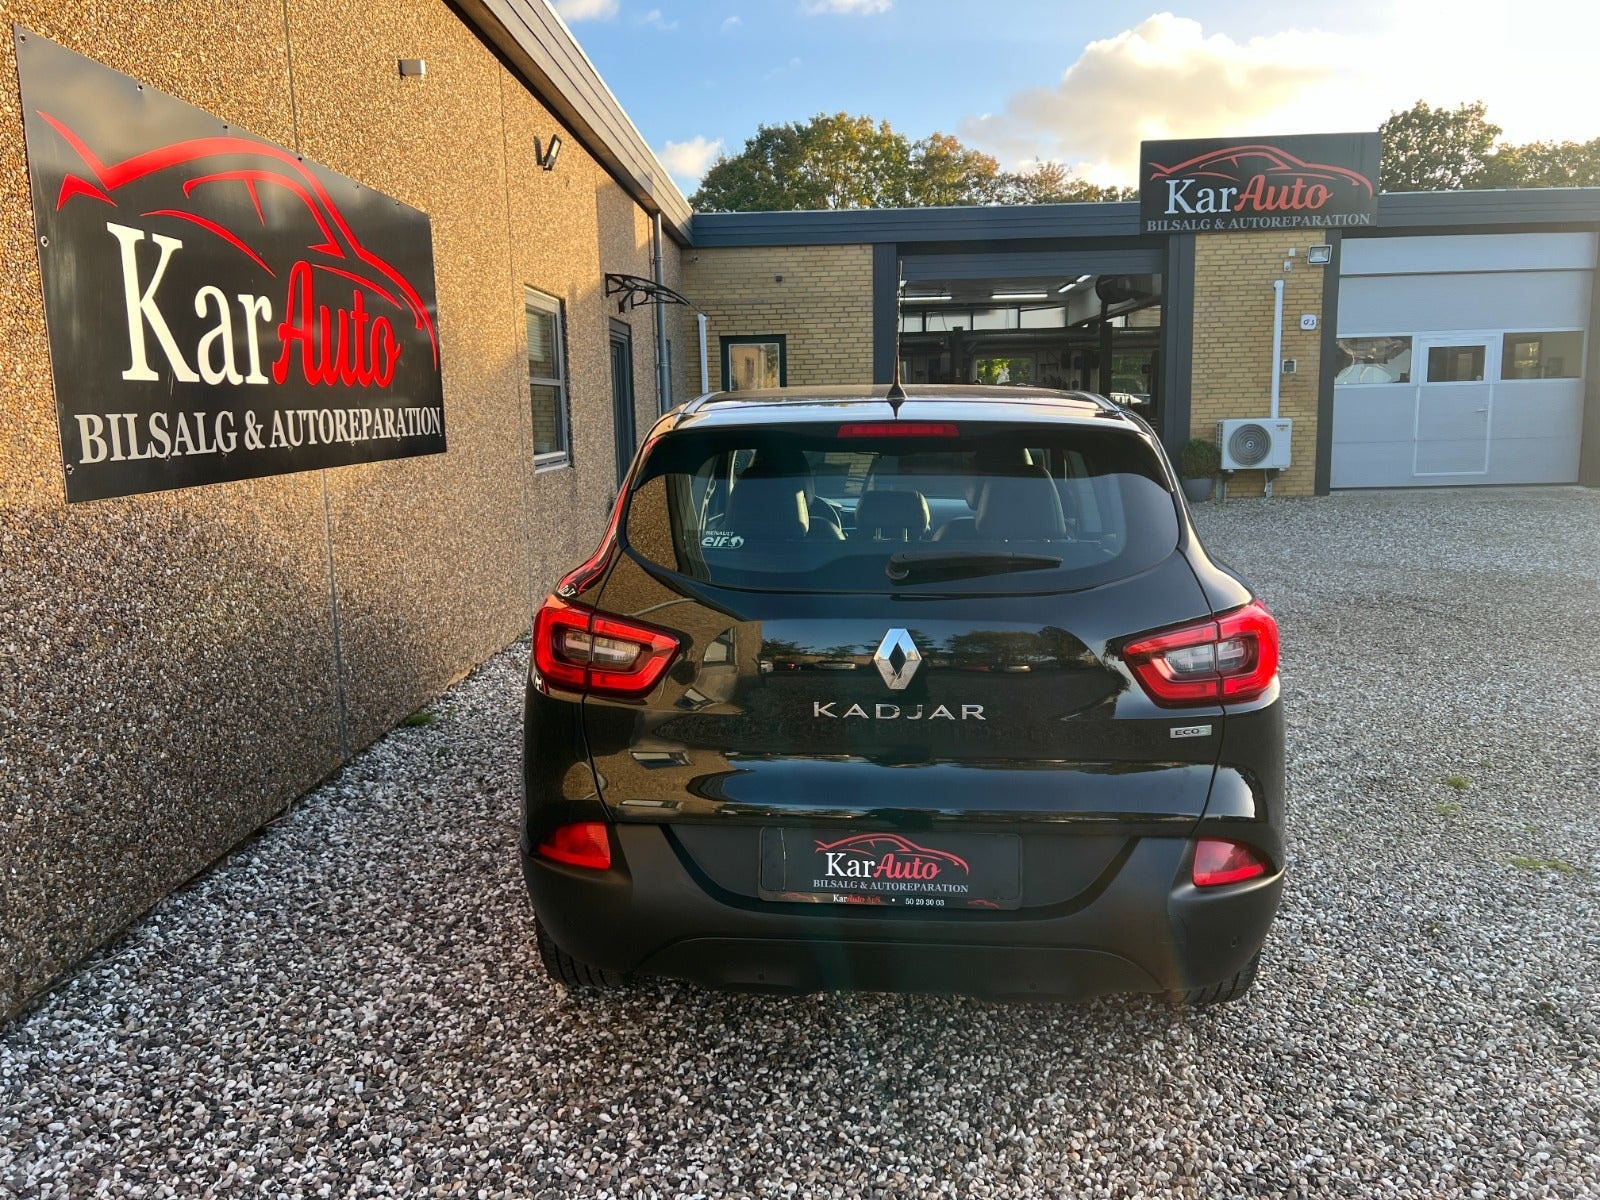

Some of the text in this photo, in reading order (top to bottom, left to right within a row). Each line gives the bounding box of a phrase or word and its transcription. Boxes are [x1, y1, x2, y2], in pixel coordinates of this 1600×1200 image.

[1164, 174, 1333, 214] KarAuto
[1147, 213, 1372, 232] BILSALG & AUTOREPARATION
[107, 222, 401, 389] KarAuto
[74, 407, 442, 465] BILSALG & AUTOREPARATION
[813, 701, 987, 721] KADJAR
[825, 852, 942, 880] KarAuto
[813, 879, 969, 893] BILSALG & AUTOREPARATION
